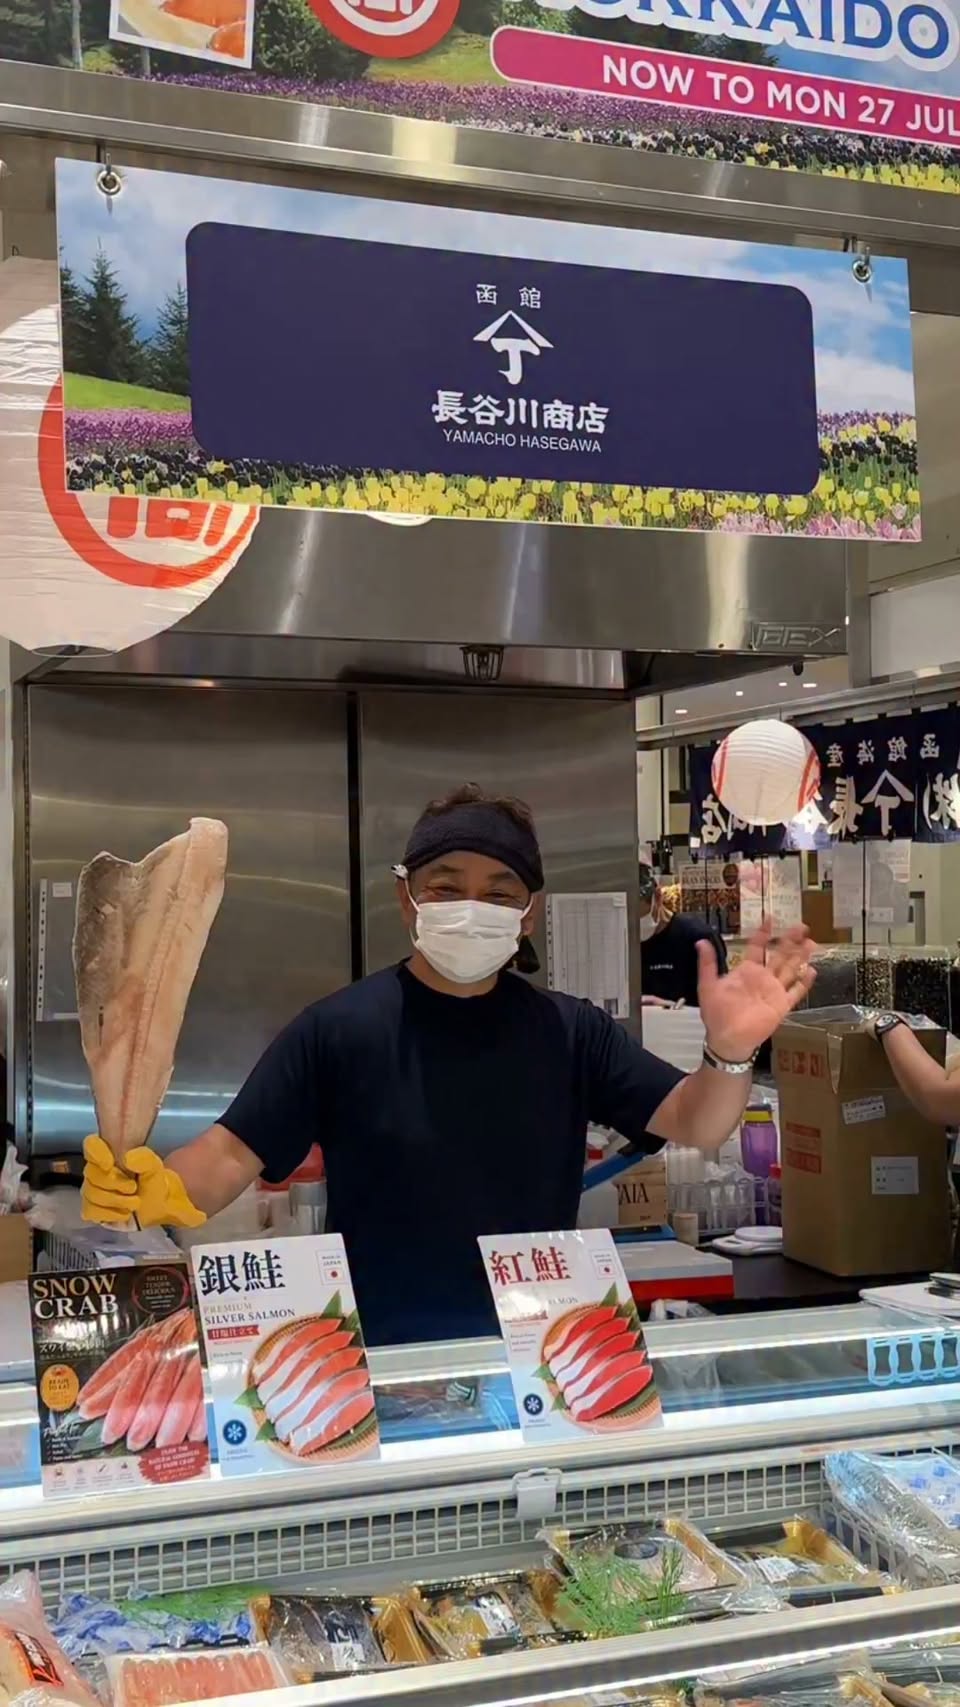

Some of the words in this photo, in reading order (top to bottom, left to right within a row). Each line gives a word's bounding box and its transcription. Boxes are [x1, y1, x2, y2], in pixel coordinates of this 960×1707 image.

[602, 55, 694, 96] NOW
[706, 71, 755, 105] TO
[767, 81, 846, 120] MON
[857, 96, 895, 126] 27
[476, 283, 541, 309] 函館
[432, 389, 610, 434] 長谷川商店
[443, 428, 517, 448] YAMACHO
[520, 435, 602, 453] HASEGAWA
[198, 1250, 285, 1296] 銀鮭
[489, 1246, 571, 1286] 紅鮭
[33, 1273, 116, 1299] SNOW
[34, 1294, 119, 1319] CRAB
[203, 1303, 252, 1314] PREMIUM
[204, 1313, 246, 1326] SILVER
[248, 1309, 296, 1322] SALMON
